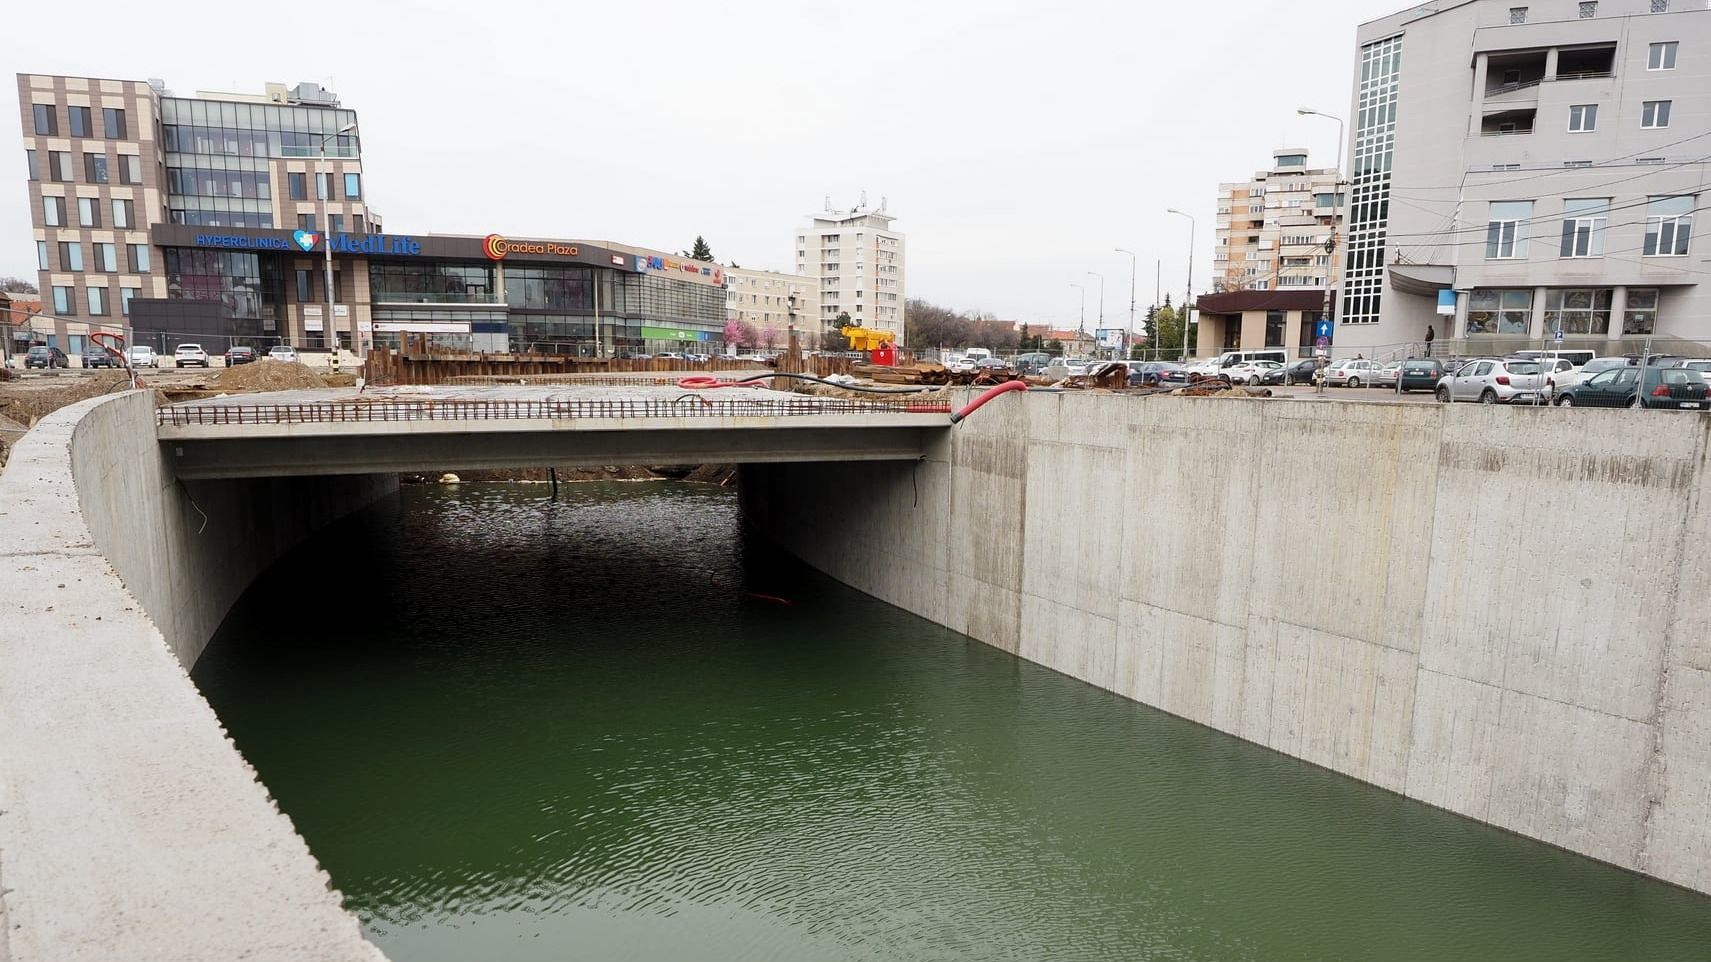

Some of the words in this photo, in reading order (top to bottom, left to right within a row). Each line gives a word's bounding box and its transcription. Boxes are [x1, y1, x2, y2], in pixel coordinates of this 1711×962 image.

[196, 234, 289, 249] HYPERCLINICA
[327, 233, 421, 256] MedLife
[493, 238, 544, 255] Oradea
[547, 243, 578, 255] Plaza
